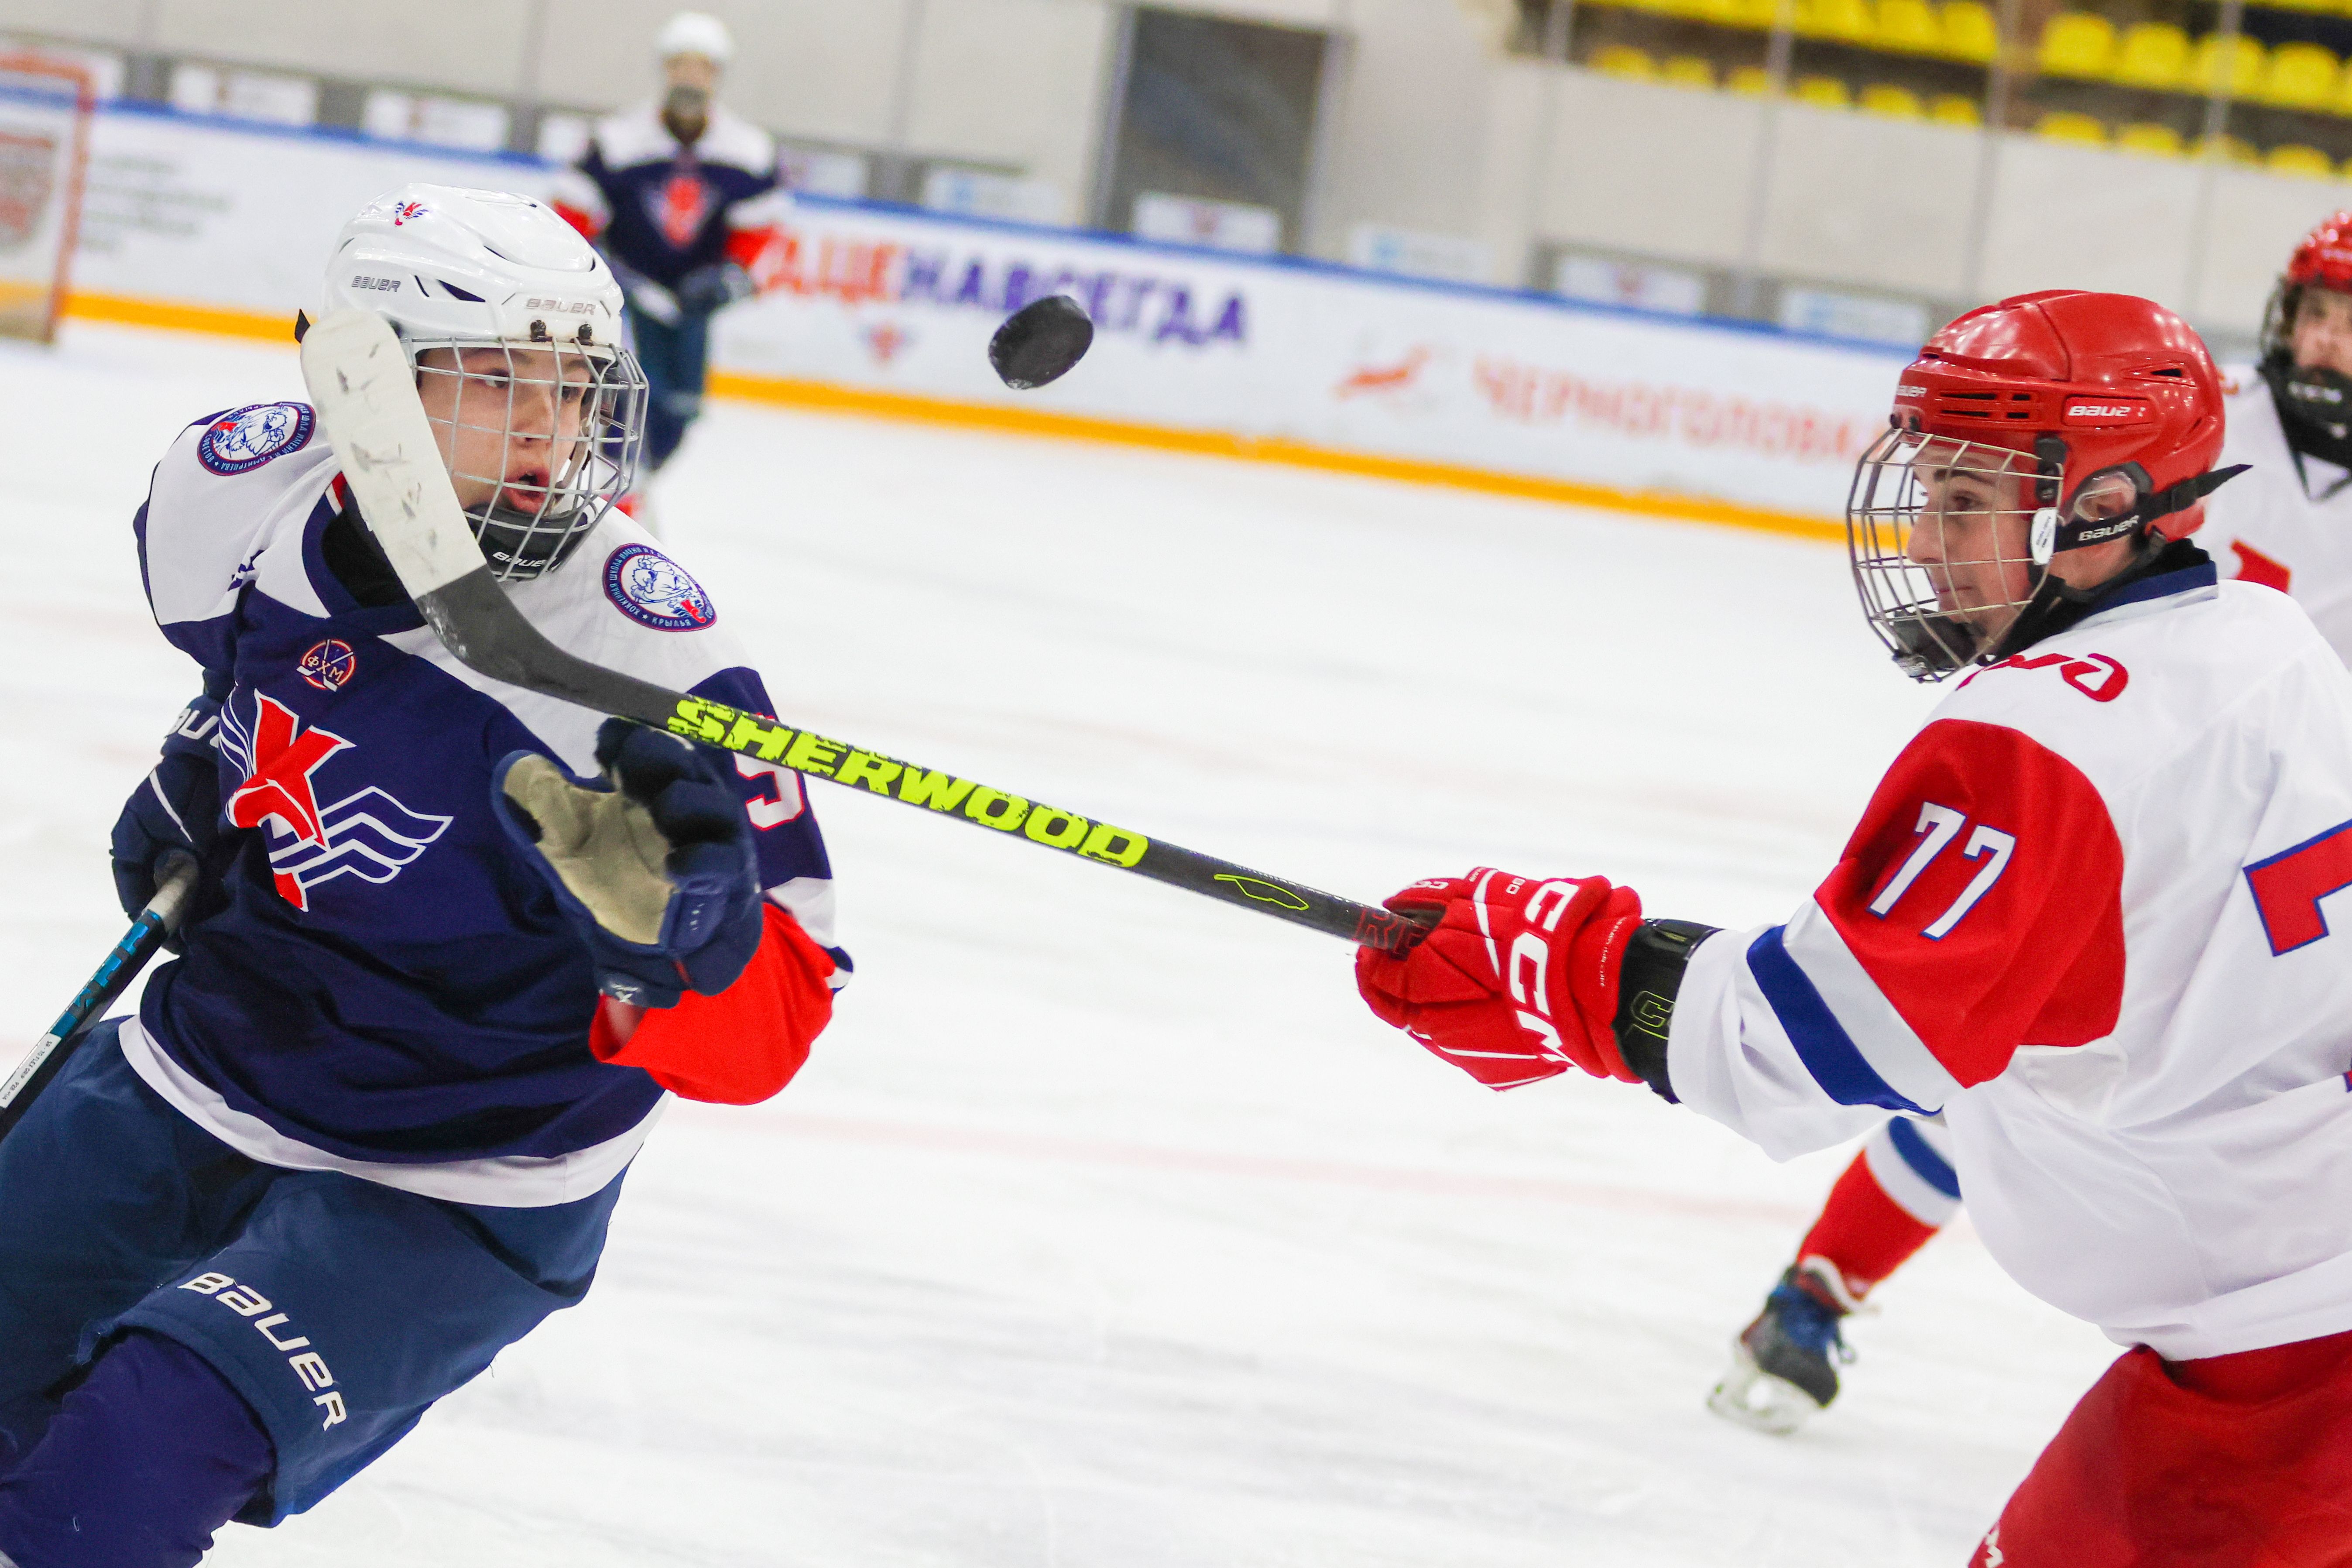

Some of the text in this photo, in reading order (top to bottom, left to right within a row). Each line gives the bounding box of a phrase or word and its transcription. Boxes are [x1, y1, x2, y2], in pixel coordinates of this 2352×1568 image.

[525, 298, 596, 316] BAUER
[307, 655, 345, 682] ФХМ
[667, 695, 1148, 868] SHERWOOD
[1865, 801, 2017, 941] 77
[177, 1272, 346, 1431] BAUER
